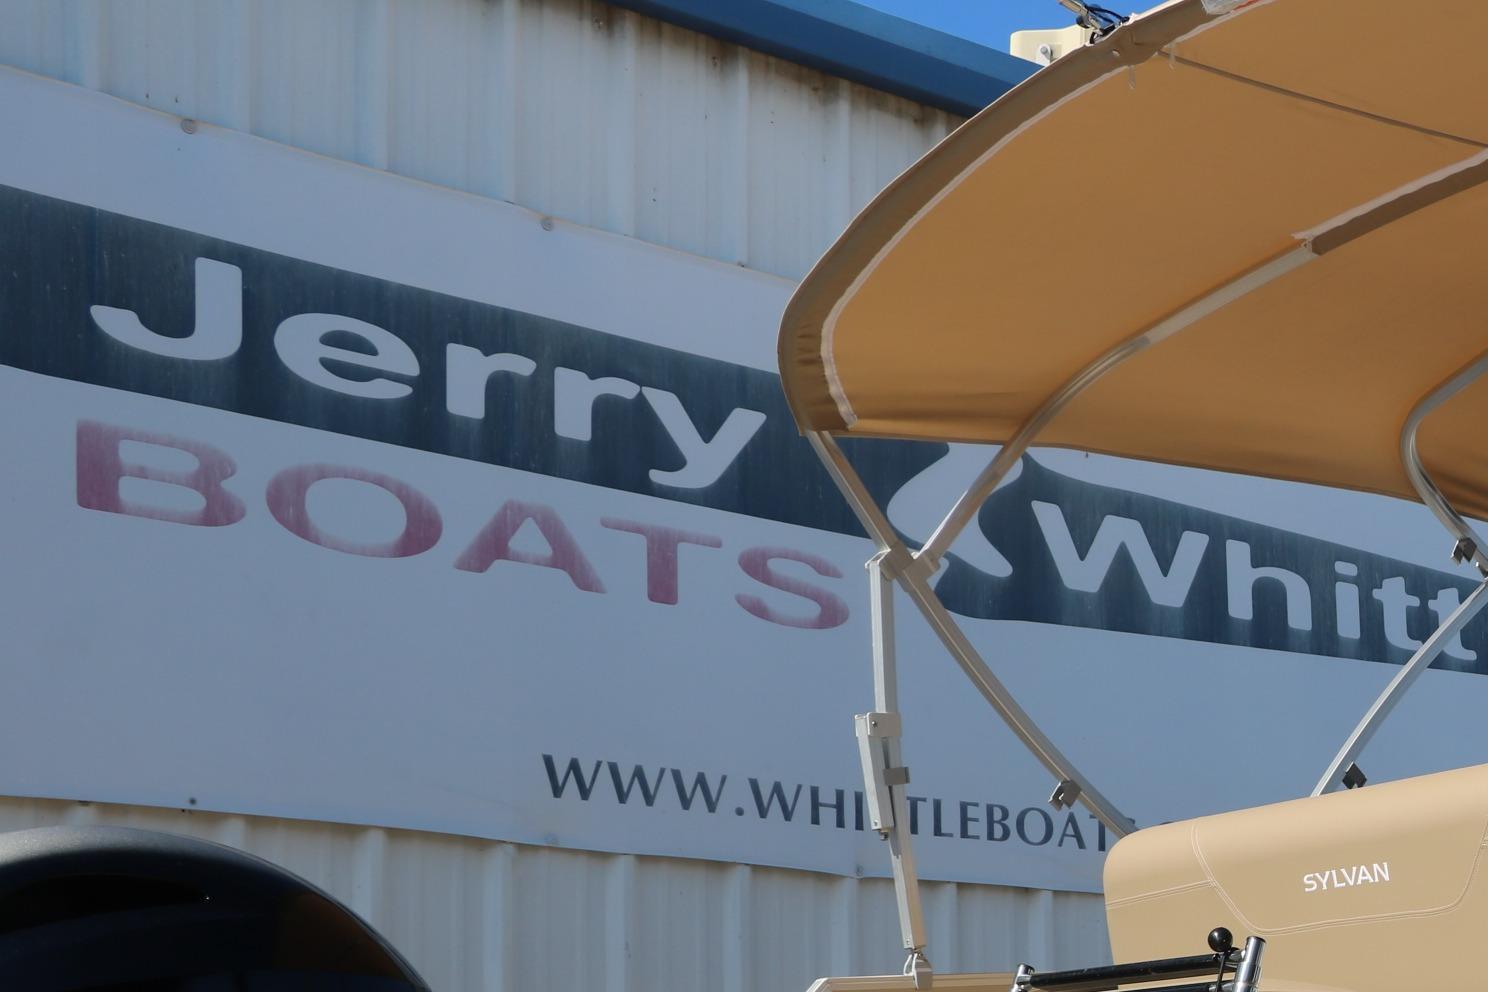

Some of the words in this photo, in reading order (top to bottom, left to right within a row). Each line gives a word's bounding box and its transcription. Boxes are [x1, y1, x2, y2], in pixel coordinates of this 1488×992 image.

[90, 257, 767, 488] Jerry
[75, 419, 851, 630] BOATS
[1302, 861, 1391, 893] SYLVAN
